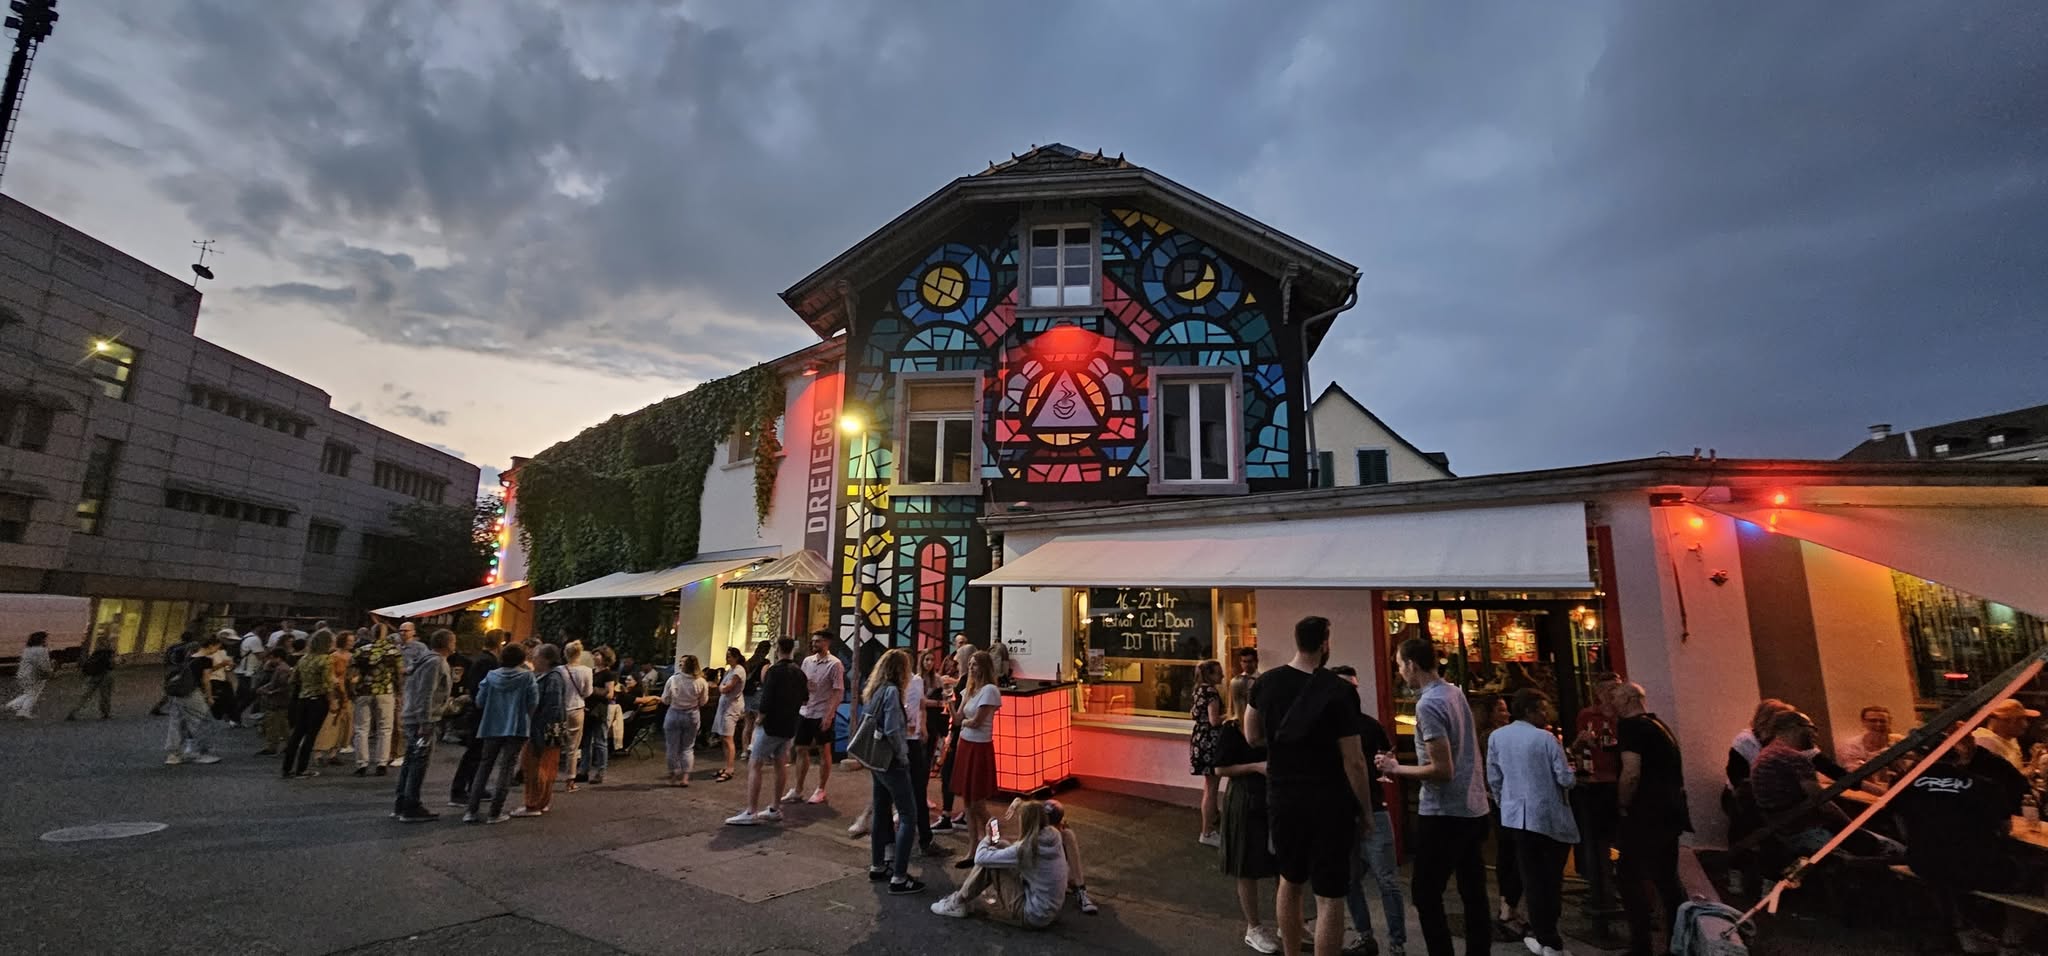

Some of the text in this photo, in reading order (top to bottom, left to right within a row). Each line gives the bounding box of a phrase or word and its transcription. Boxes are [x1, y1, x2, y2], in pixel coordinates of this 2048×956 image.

[807, 407, 834, 534] DREIEGG
[1156, 591, 1178, 609] Uhr
[1121, 632, 1142, 650] DJ
[1914, 776, 1974, 789] CREW
